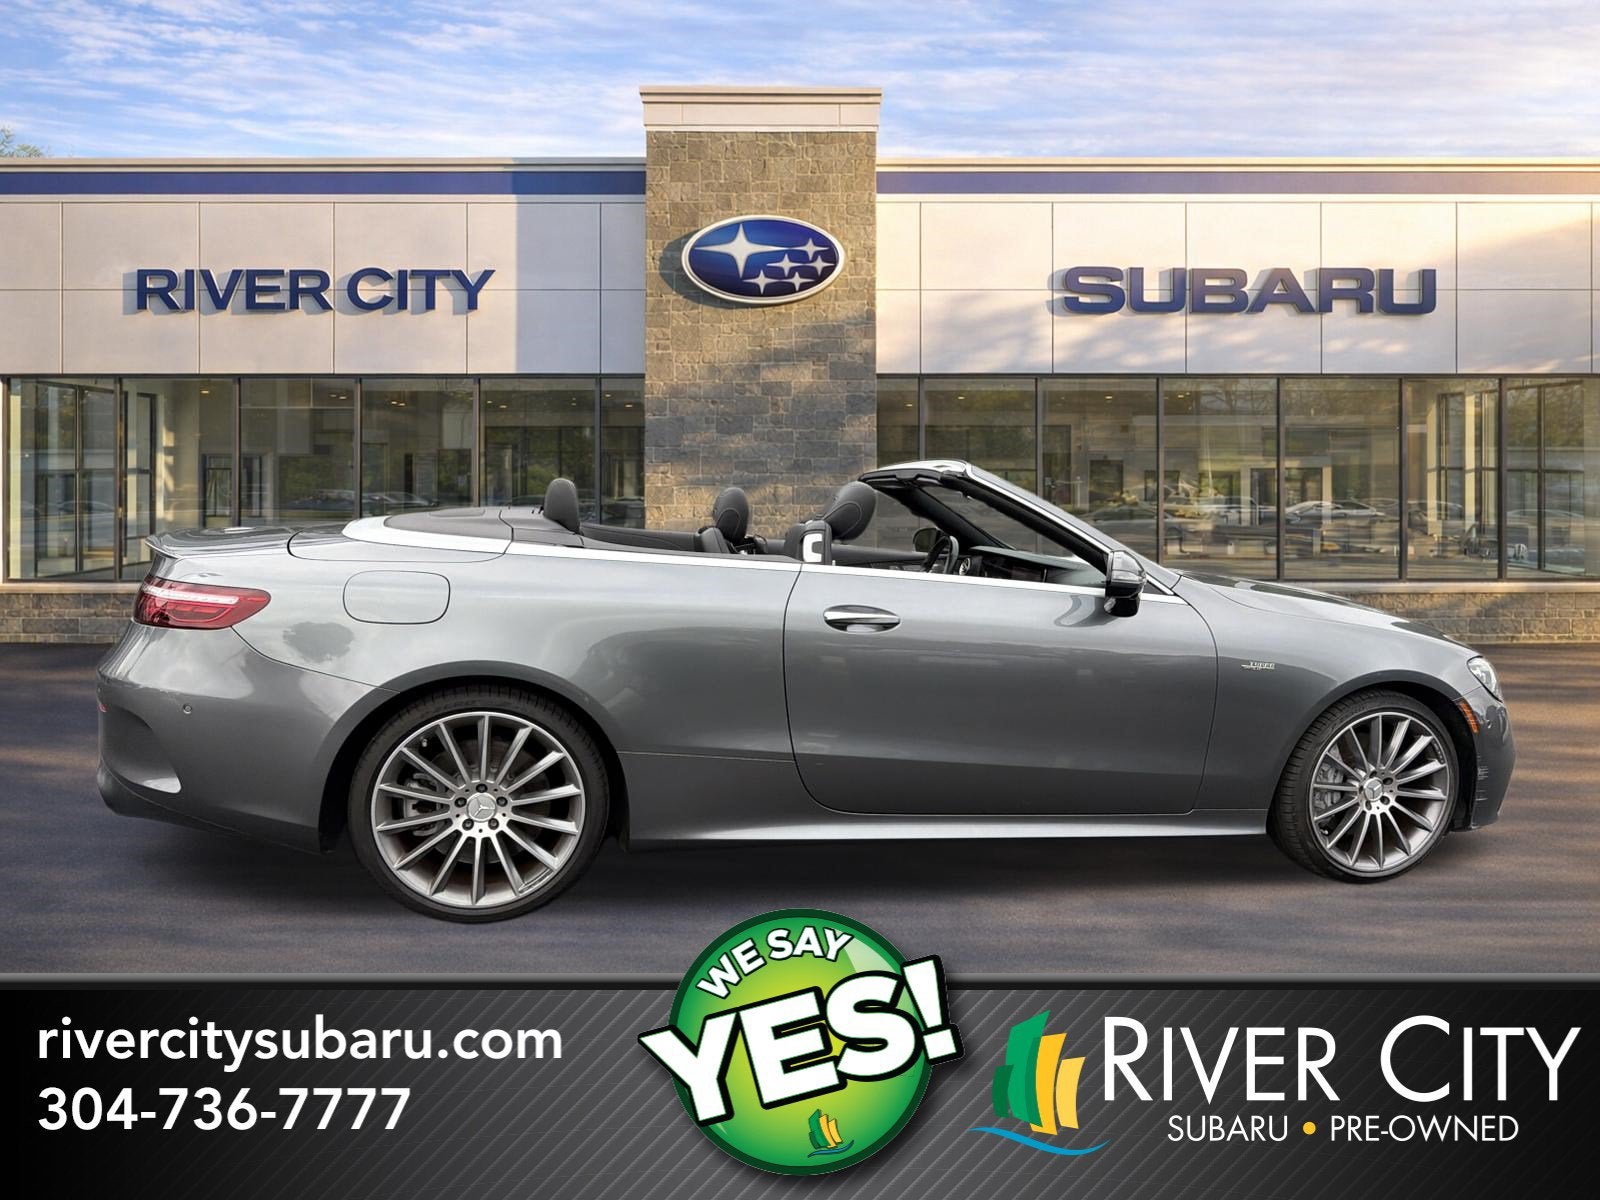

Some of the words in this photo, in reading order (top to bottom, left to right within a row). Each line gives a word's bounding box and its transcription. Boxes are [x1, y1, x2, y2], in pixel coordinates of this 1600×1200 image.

[136, 269, 332, 312] RIVER
[347, 267, 495, 312] CITY
[1063, 266, 1437, 315] SUBARU
